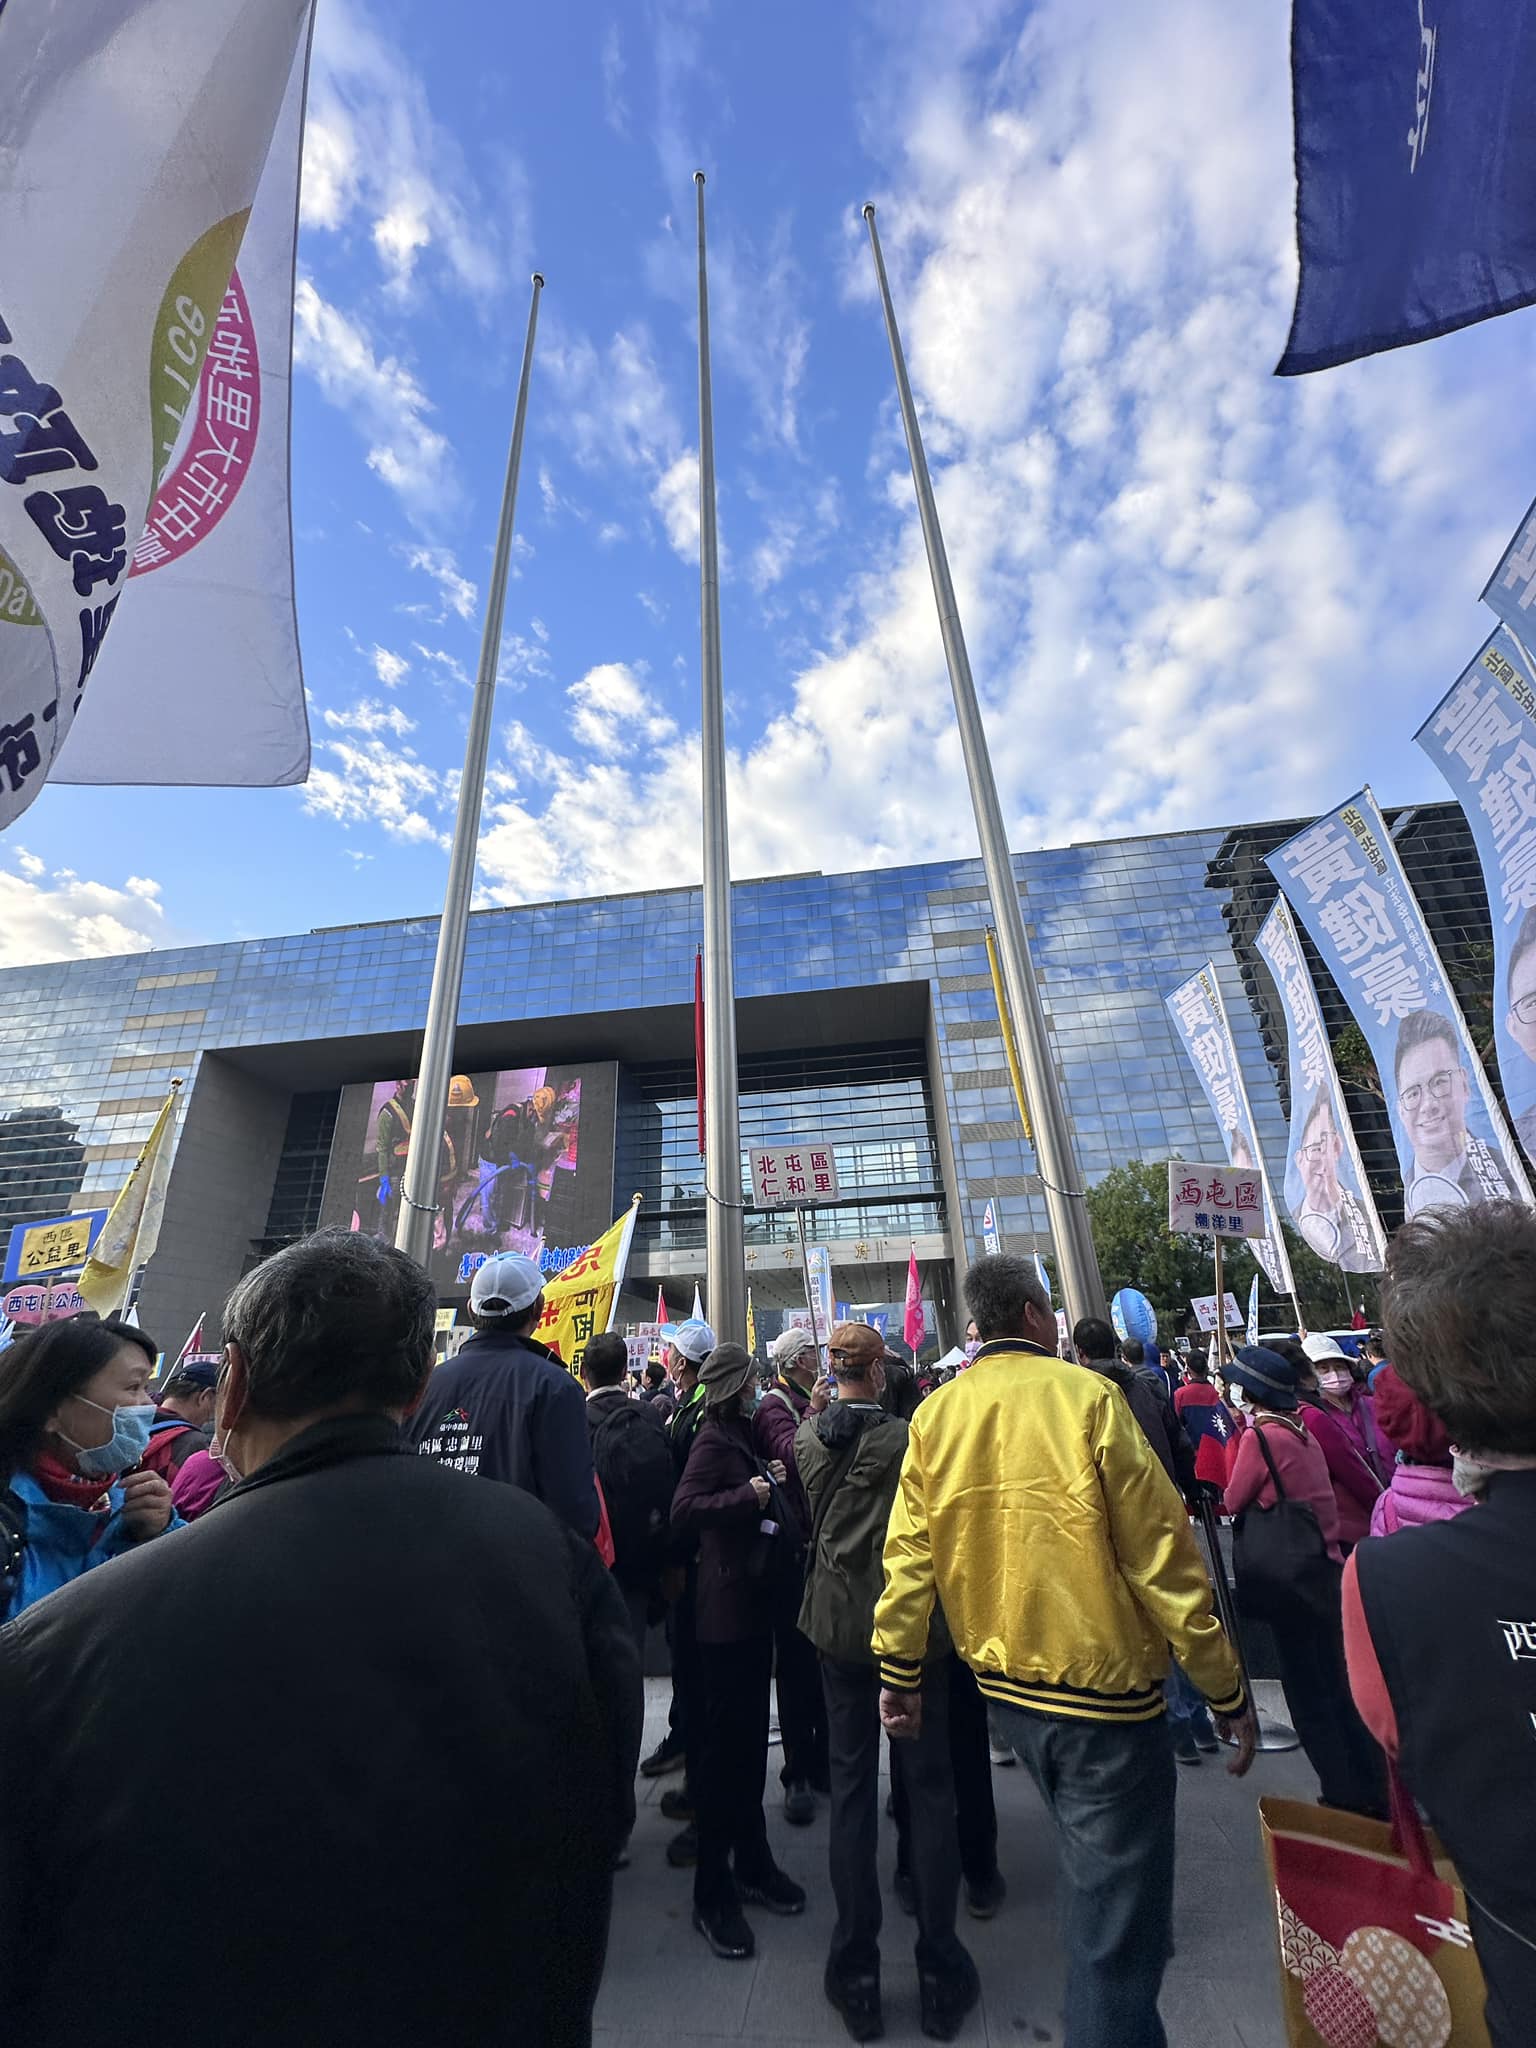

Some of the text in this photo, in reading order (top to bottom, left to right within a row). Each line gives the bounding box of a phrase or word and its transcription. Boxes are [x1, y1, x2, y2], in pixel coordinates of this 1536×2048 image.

[758, 1152, 829, 1175] 北屯區
[761, 1173, 833, 1197] 仁和里
[1175, 1178, 1260, 1211] 西屯區
[43, 1226, 73, 1244] 西區
[27, 1242, 80, 1266] 公益里
